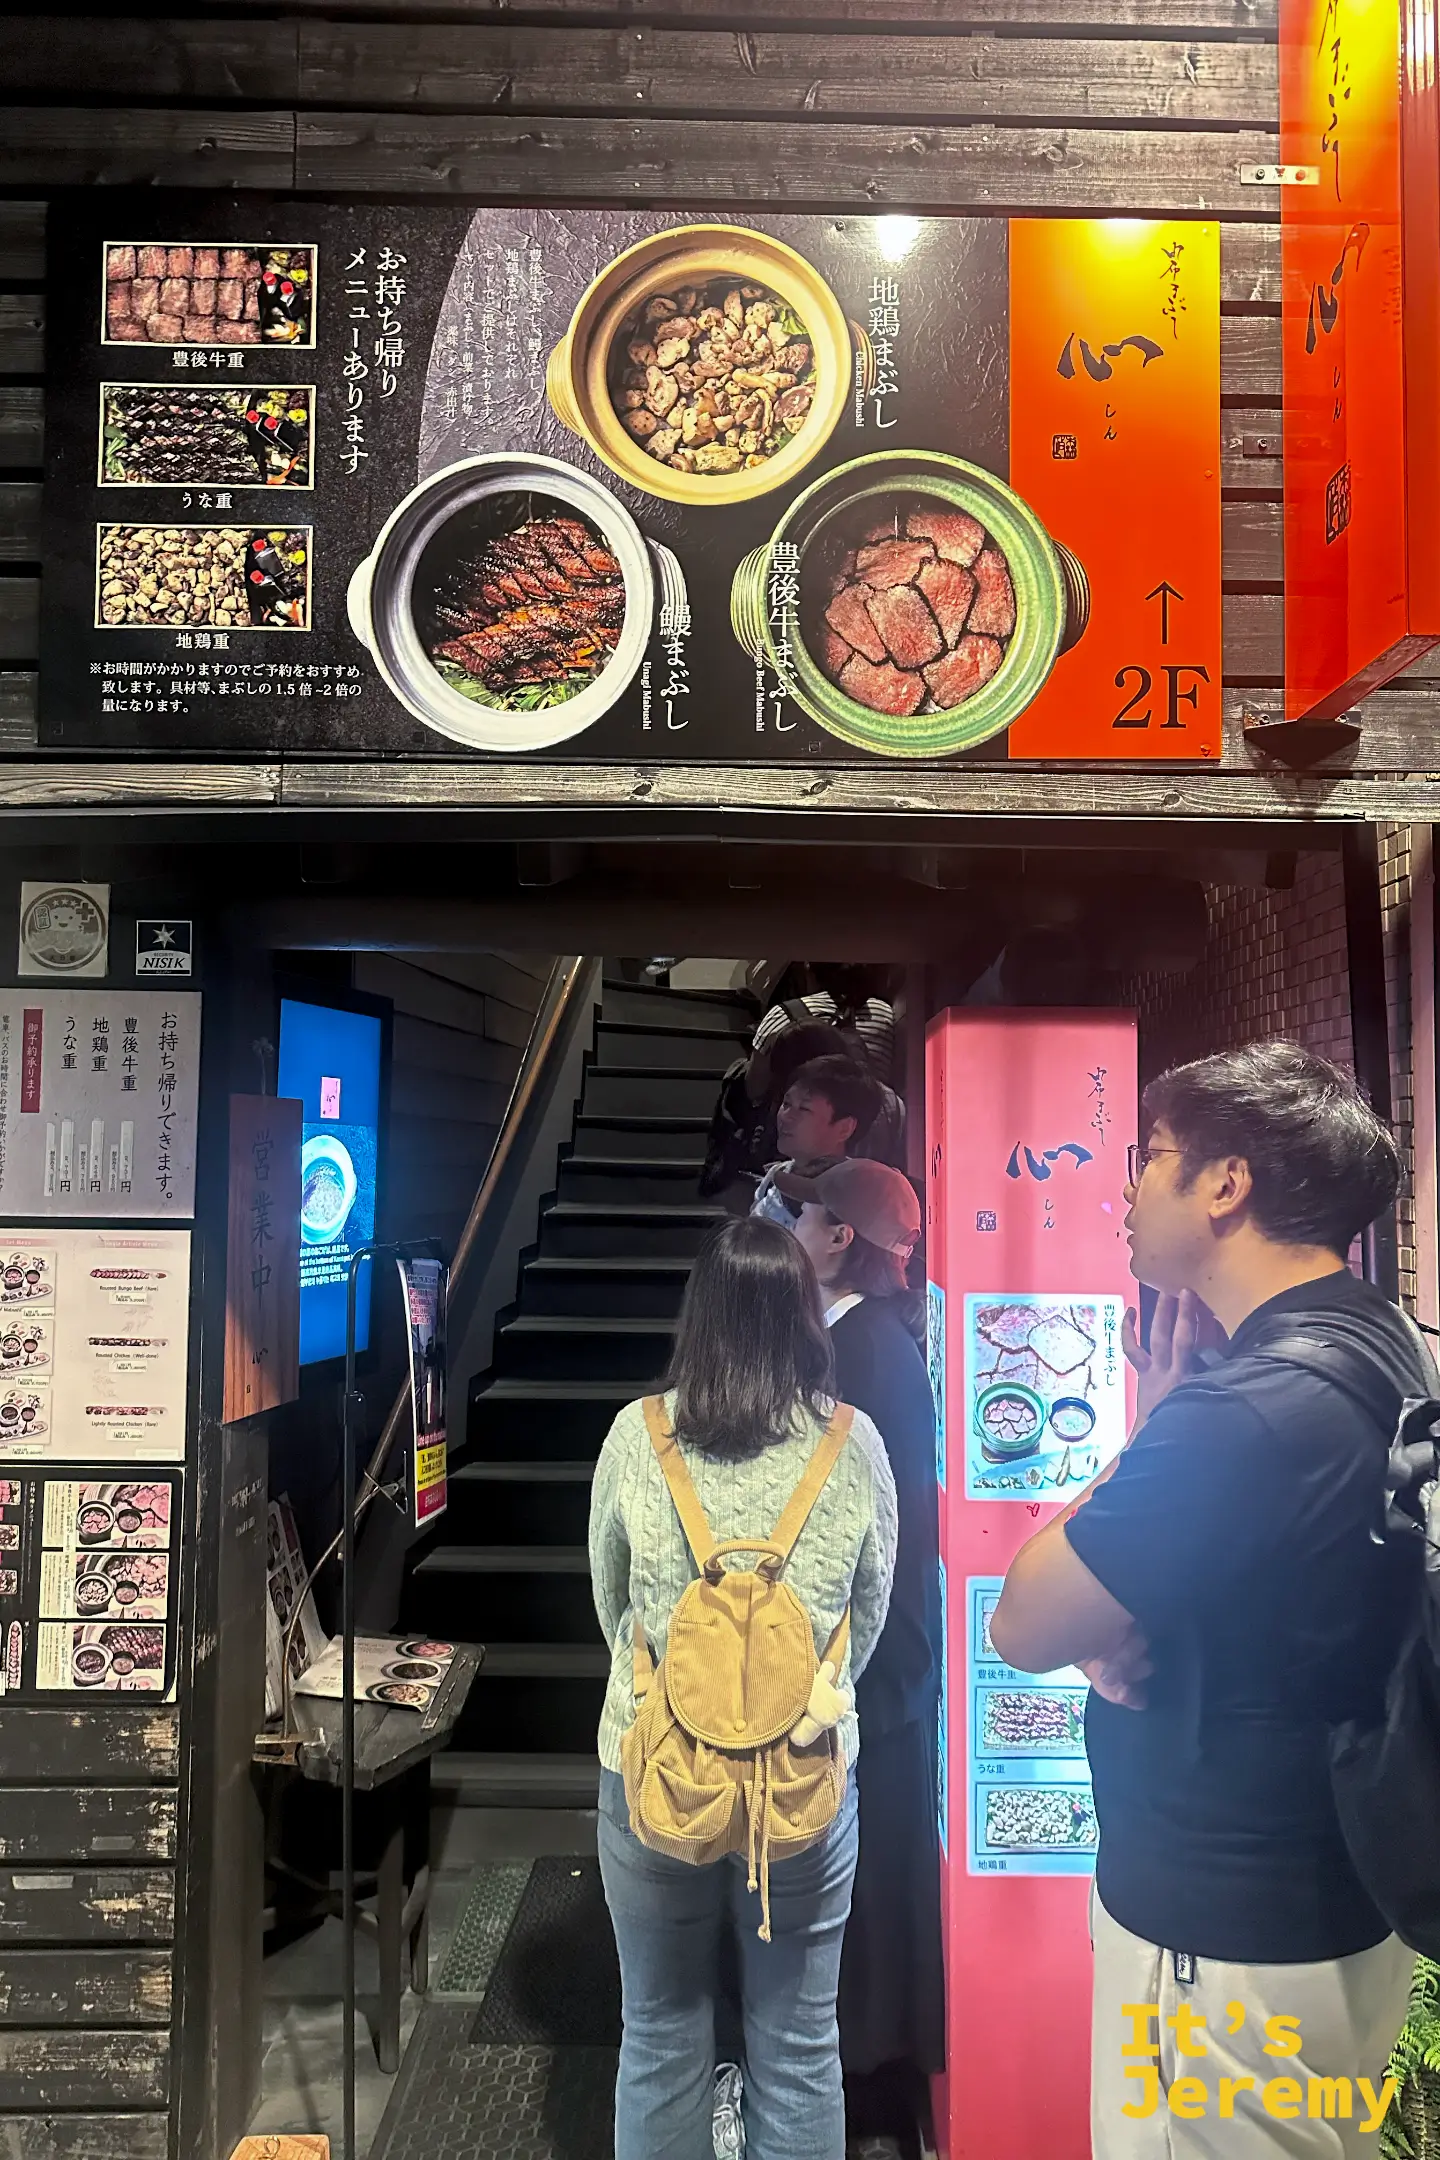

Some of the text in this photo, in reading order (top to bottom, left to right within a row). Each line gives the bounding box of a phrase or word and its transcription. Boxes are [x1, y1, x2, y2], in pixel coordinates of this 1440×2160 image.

[373, 246, 408, 399] お持ち帰り
[172, 350, 245, 369] 豊後牛重
[339, 247, 371, 476] メニューあります
[867, 276, 901, 429] 地鶏まぶし
[1056, 332, 1165, 383] 心
[855, 388, 865, 428] Mabushi
[1102, 403, 1118, 441] しん
[181, 491, 233, 510] うな重
[175, 632, 230, 651] 地鶏重
[768, 541, 801, 732] 豊後牛まぶし
[659, 603, 692, 730] 鰻まぶし
[756, 669, 765, 691] Beef
[101, 699, 191, 714] 量になります。
[640, 661, 652, 730] Unagi Mabushi
[755, 692, 765, 732] Mabushi
[1112, 665, 1211, 728] 2F
[142, 957, 186, 970] NISIK
[25, 1023, 39, 1100] 御予約承ります
[61, 1016, 78, 1070] うな重
[91, 1016, 110, 1072] 地鶏重
[120, 1016, 139, 1092] 豊後牛重
[156, 1011, 179, 1200] お持ち帰りできます。
[1006, 1141, 1093, 1181] 心
[251, 1128, 274, 1310] 営業中
[1043, 1199, 1055, 1229] しん
[977, 1669, 1017, 1680] 豊後牛重
[977, 1764, 1006, 1775] うな重
[977, 1860, 1008, 1871] 地鶏重
